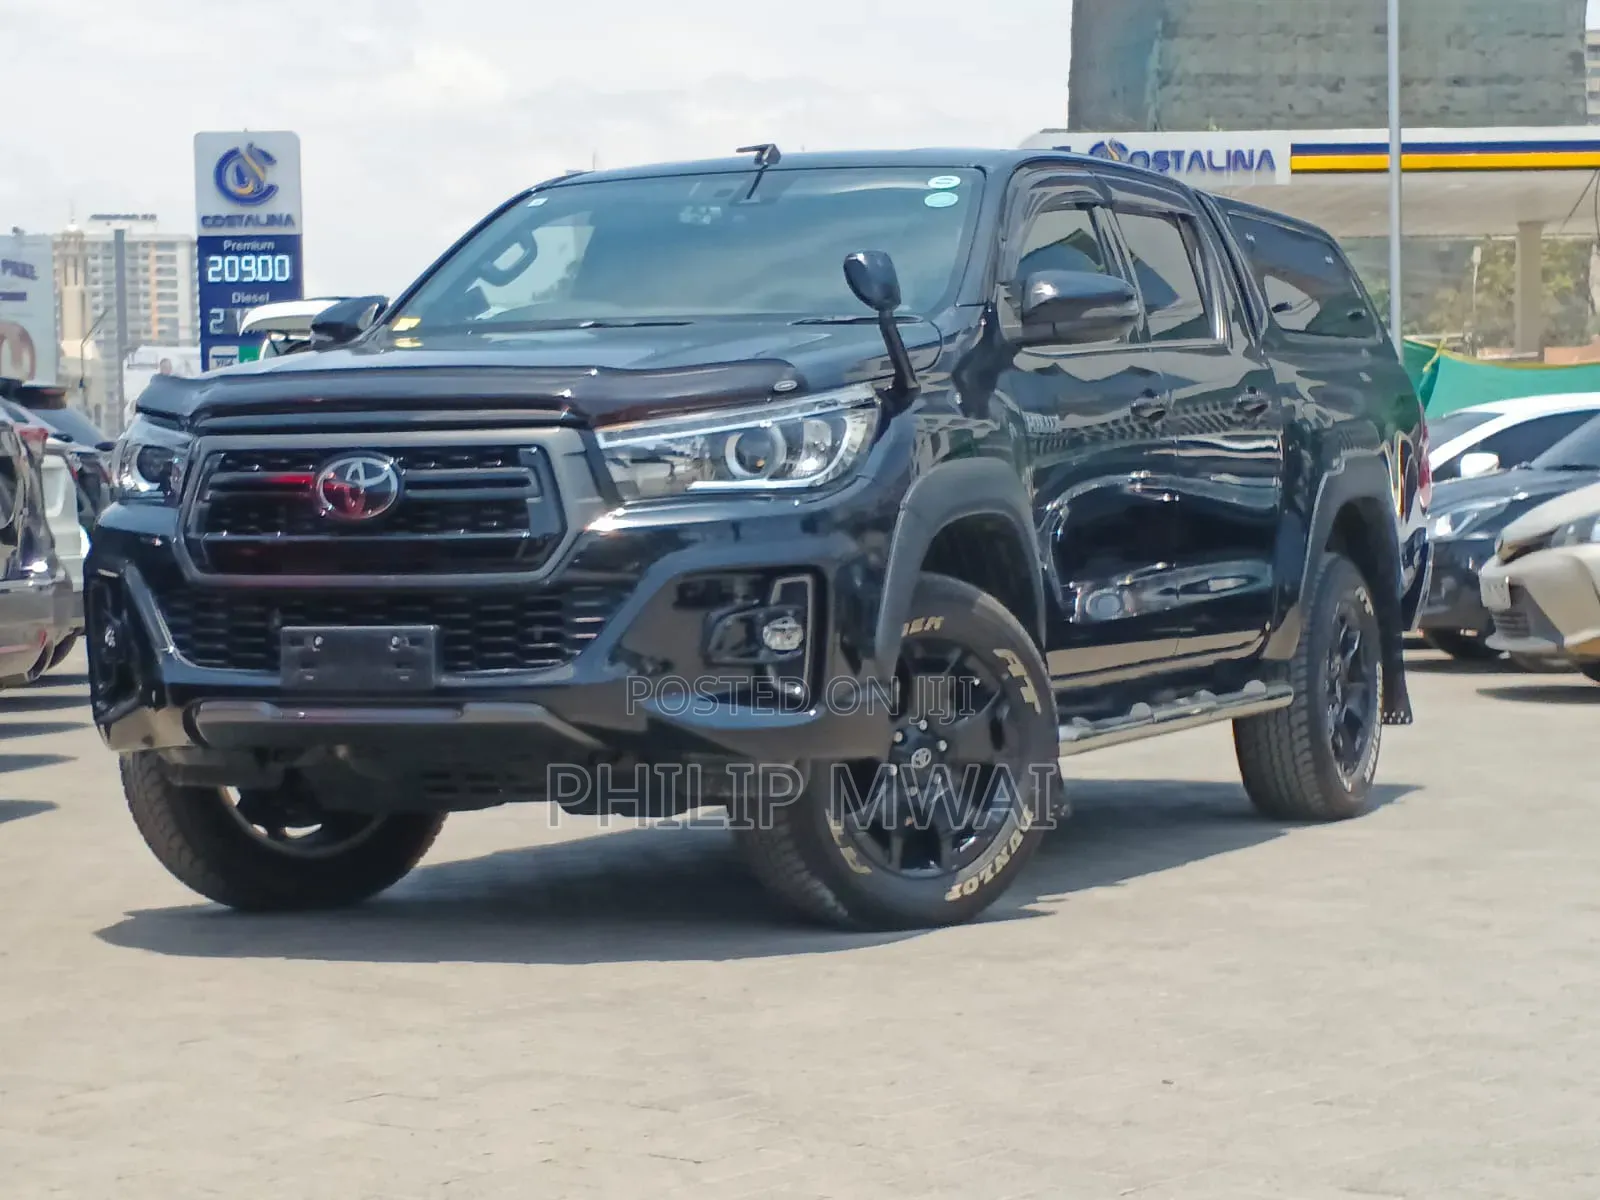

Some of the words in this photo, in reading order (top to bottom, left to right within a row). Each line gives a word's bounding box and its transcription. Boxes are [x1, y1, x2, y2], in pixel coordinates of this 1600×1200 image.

[201, 213, 295, 229] COSTALINA
[223, 239, 275, 251] Premium
[231, 291, 270, 304] Diesel
